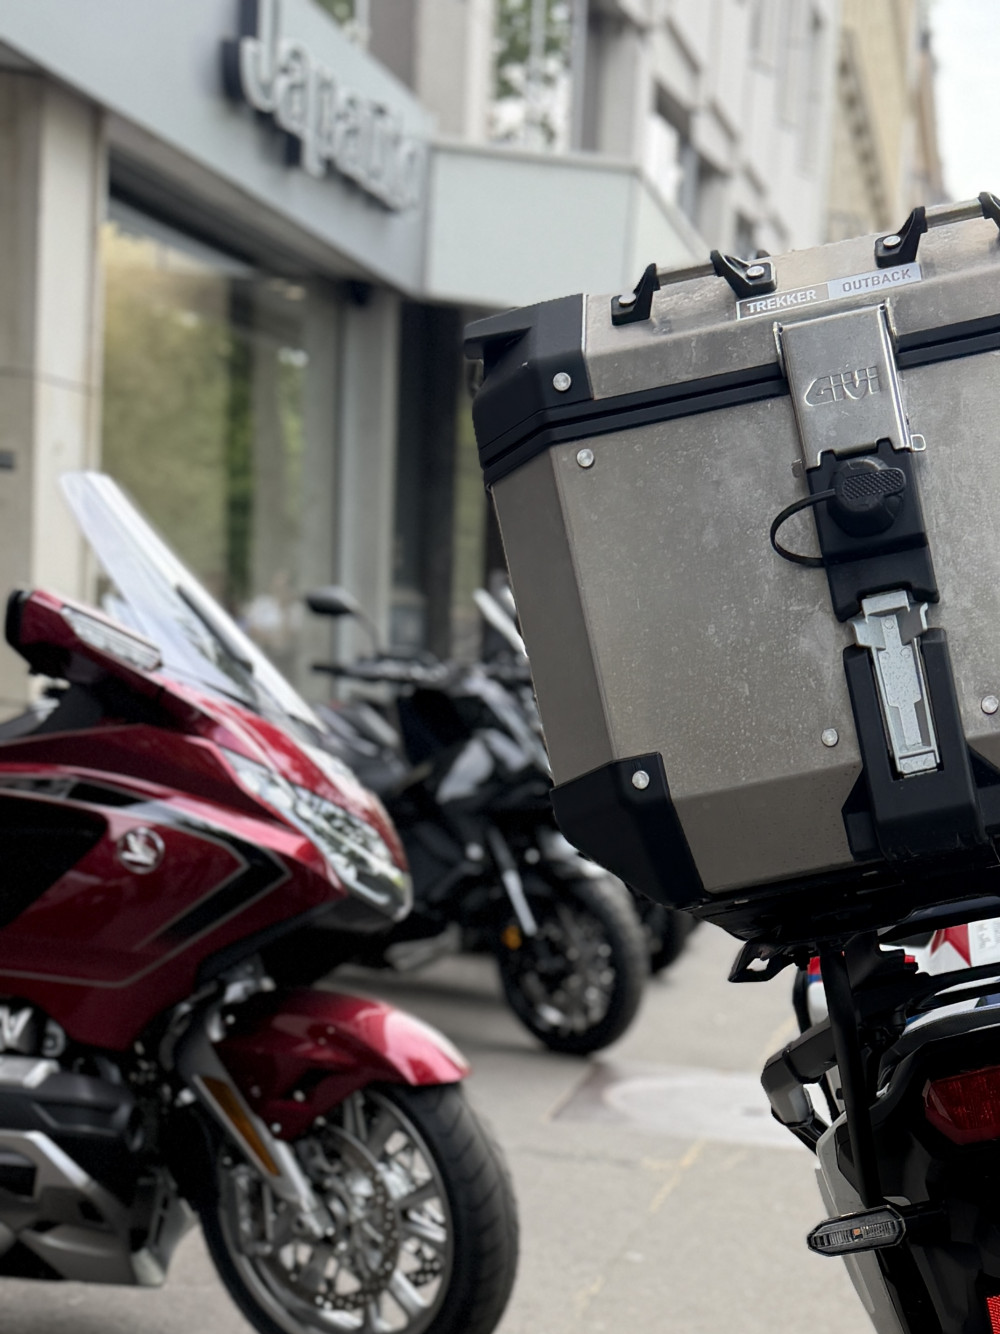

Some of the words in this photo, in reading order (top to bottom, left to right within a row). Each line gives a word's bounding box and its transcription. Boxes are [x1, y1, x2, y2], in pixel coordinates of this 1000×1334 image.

[746, 288, 817, 314] TREKKER
[842, 268, 912, 293] OUTBACK
[803, 365, 882, 407] GIVI
